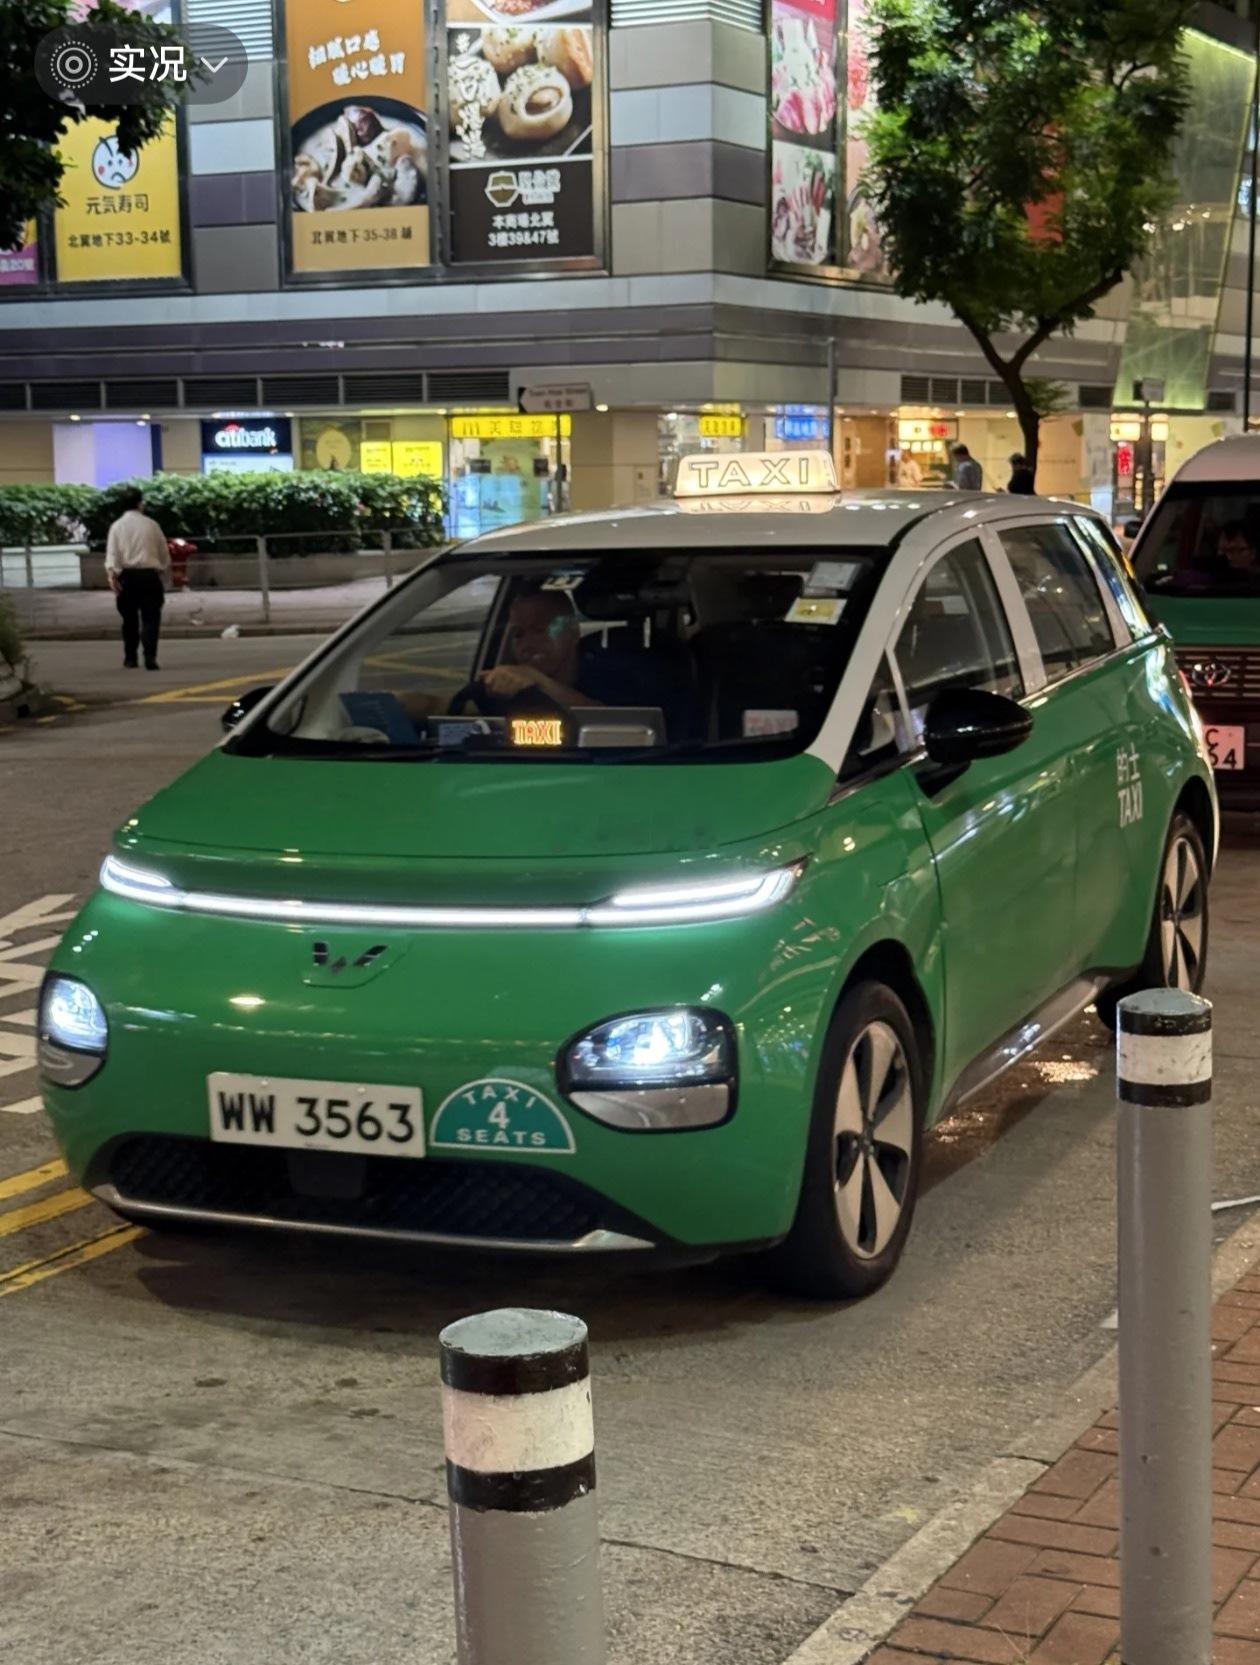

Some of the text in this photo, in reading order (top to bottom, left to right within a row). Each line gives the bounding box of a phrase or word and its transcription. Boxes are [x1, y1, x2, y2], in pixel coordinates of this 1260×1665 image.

[86, 193, 149, 215] 元気寿司
[68, 230, 171, 248] 北翼地下33-34號
[214, 426, 278, 448] citibank
[689, 457, 810, 489] TAXI
[512, 720, 562, 745] TAXI
[1117, 780, 1143, 829] TAXI
[462, 1083, 538, 1110] TAXI
[219, 1091, 416, 1144] WW 3563
[488, 1101, 511, 1130] 4
[456, 1127, 547, 1147] SEATS
